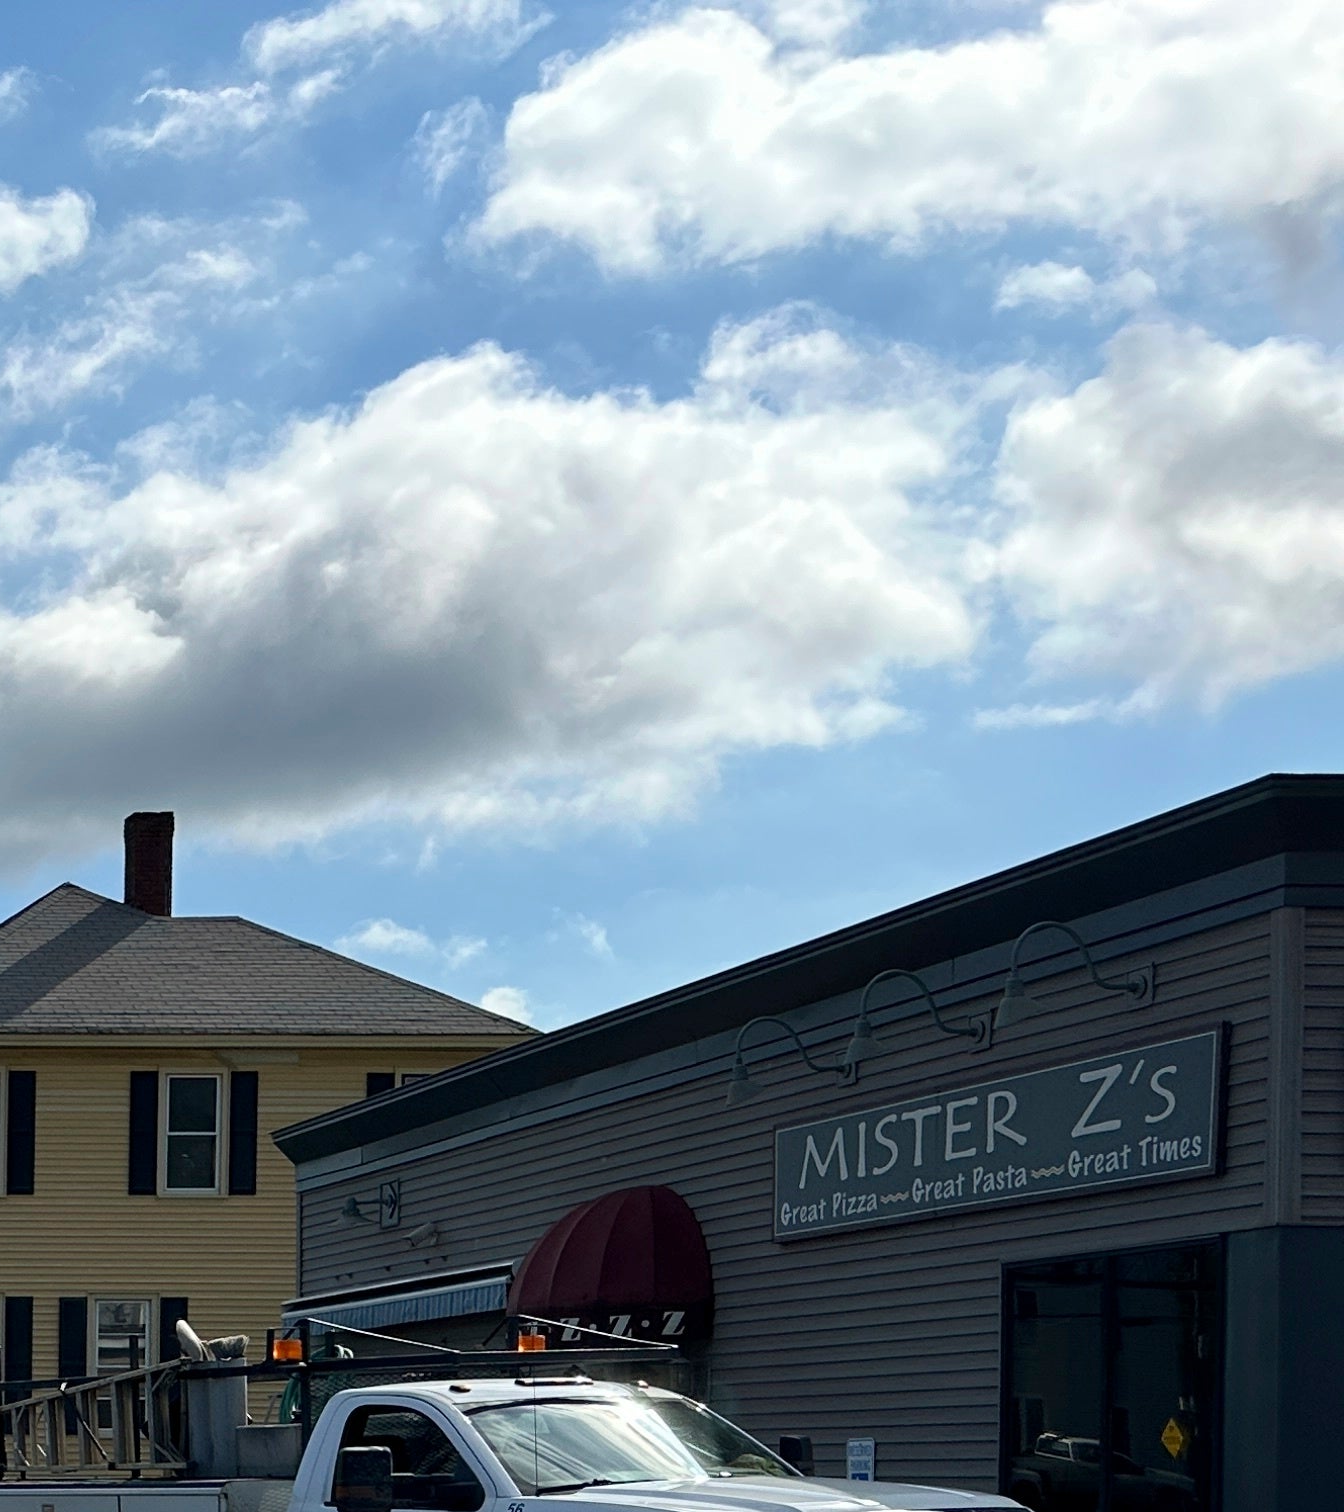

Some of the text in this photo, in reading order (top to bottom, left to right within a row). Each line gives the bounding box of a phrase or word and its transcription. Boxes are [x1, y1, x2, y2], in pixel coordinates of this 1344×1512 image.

[780, 1134, 1203, 1227] Great Pizza Great Pasta Great Times
[798, 1090, 1027, 1190] MISTER
